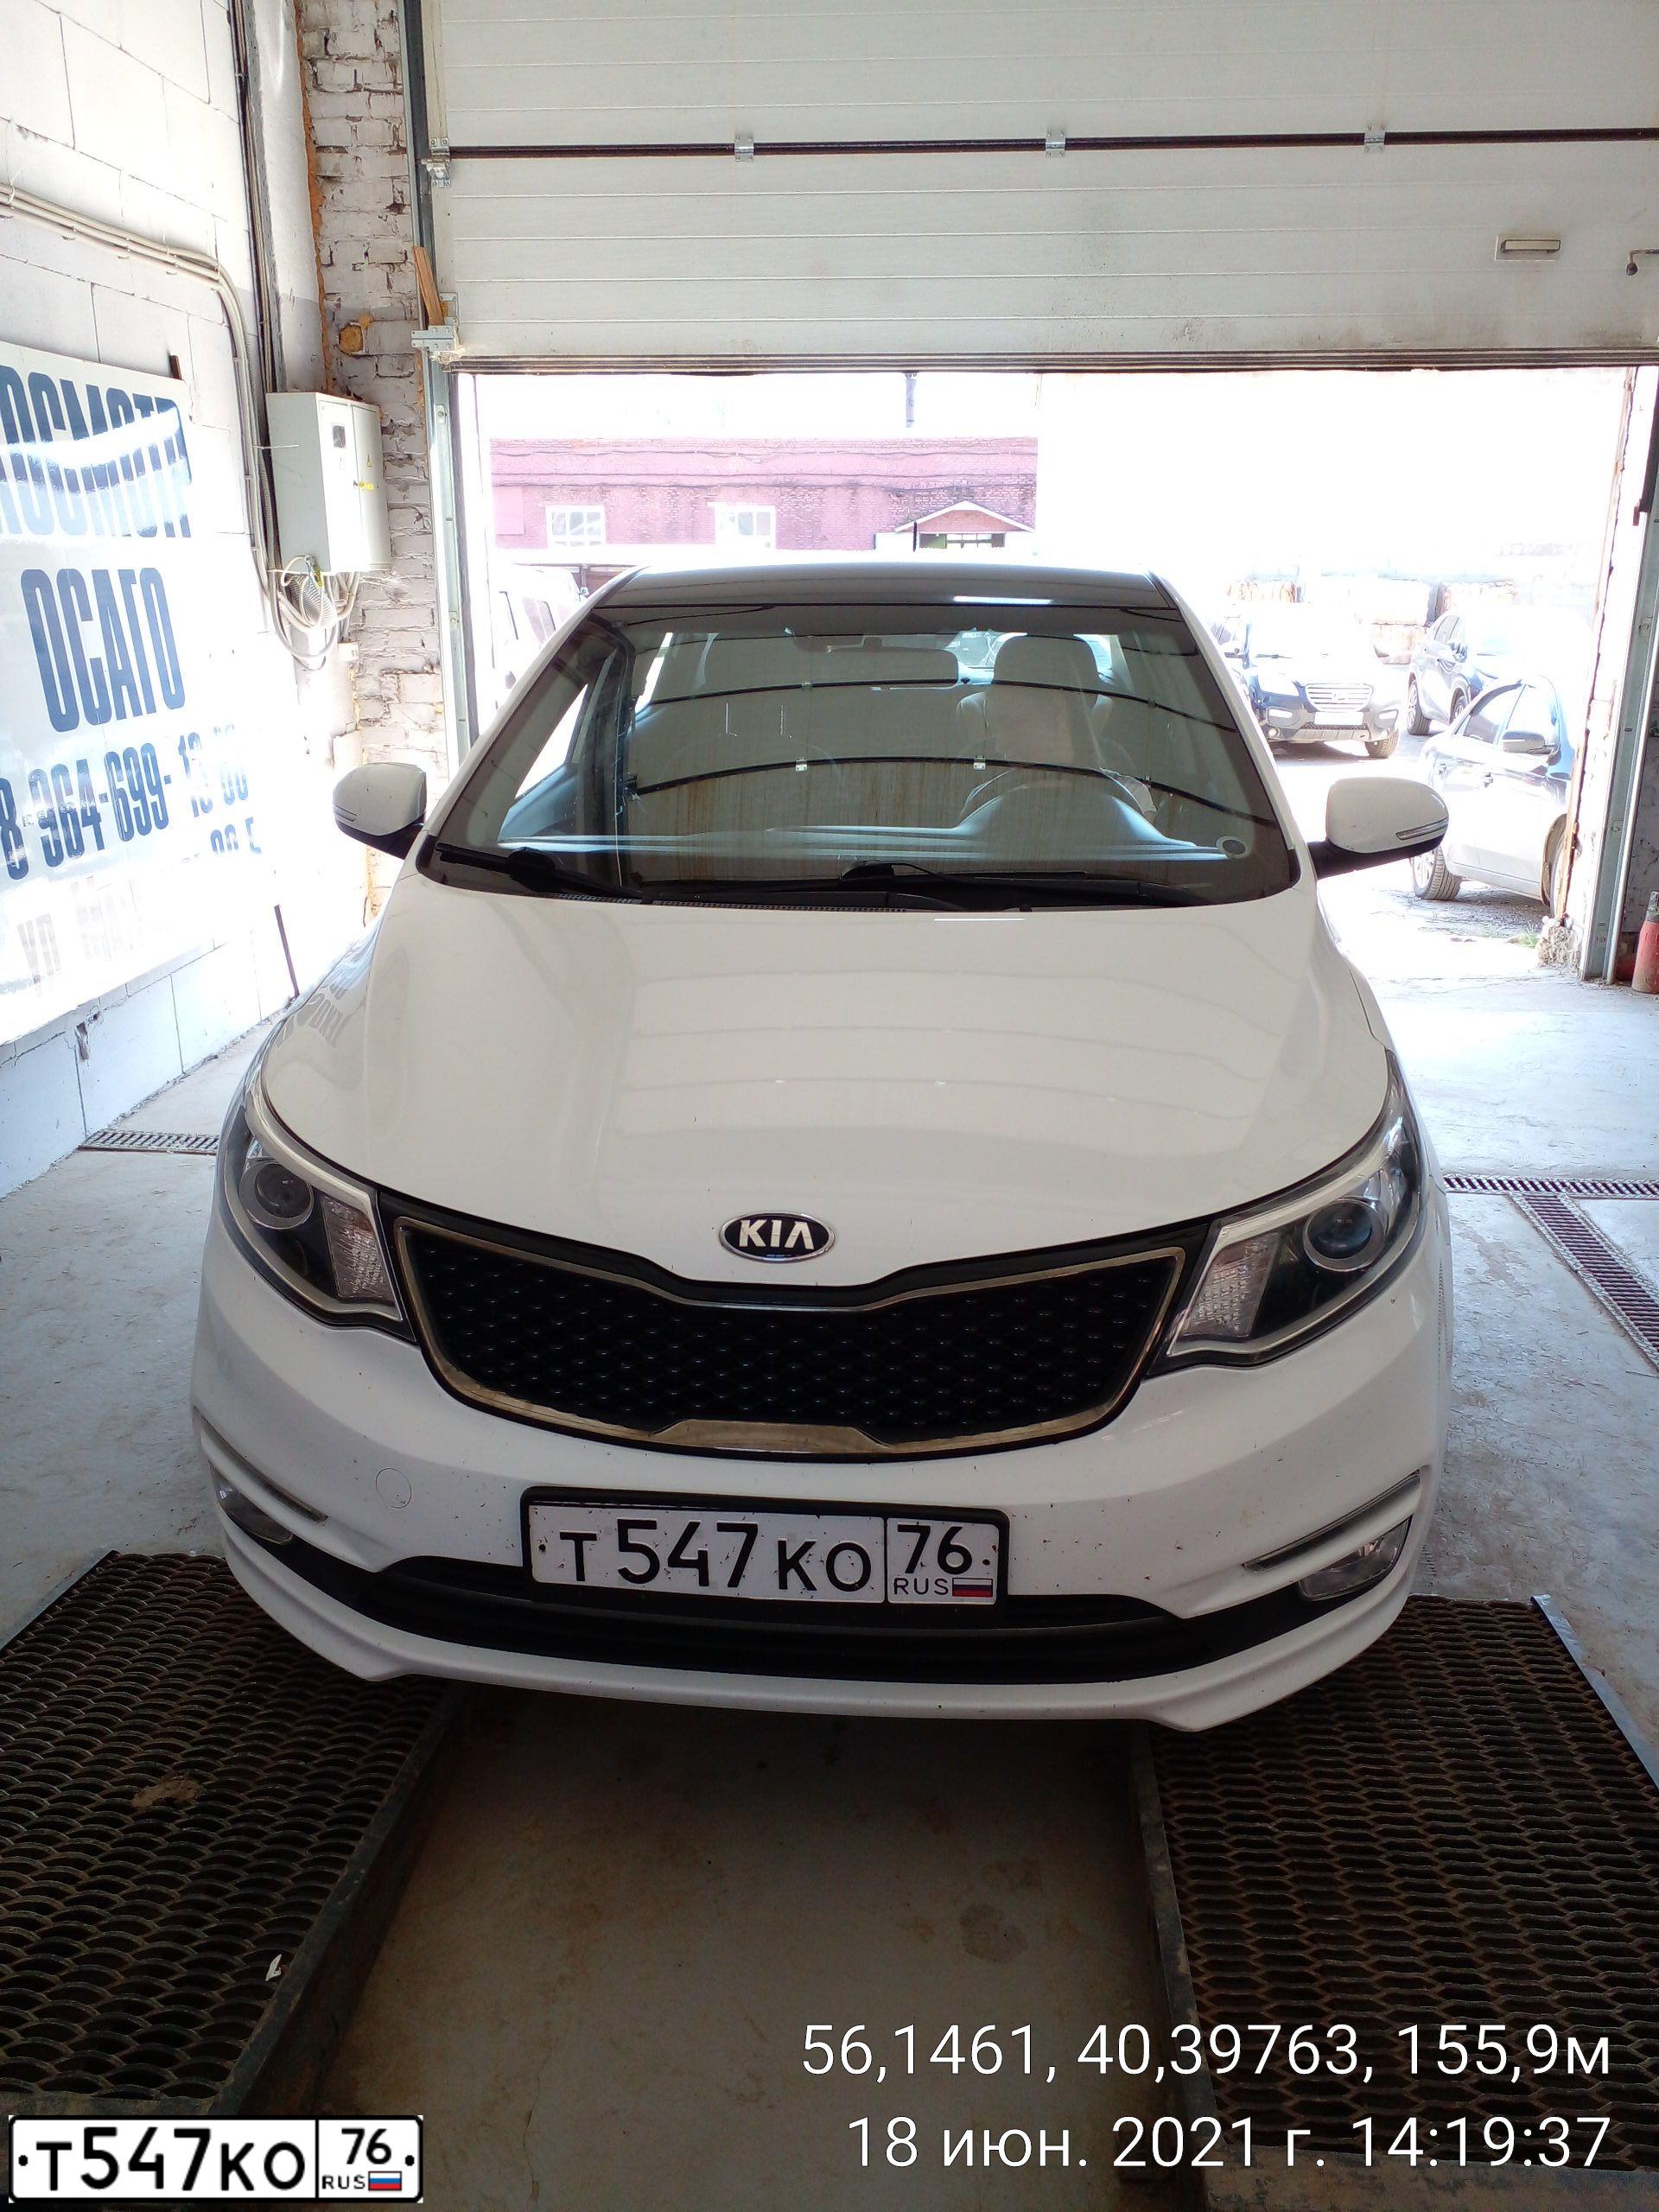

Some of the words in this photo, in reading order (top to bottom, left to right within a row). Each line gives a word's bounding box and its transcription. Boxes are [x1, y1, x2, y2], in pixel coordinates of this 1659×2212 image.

[21, 567, 186, 733] ОСАГО
[739, 1219, 815, 1250] KIA
[896, 1524, 973, 1575] 76
[893, 1578, 950, 1596] RUS
